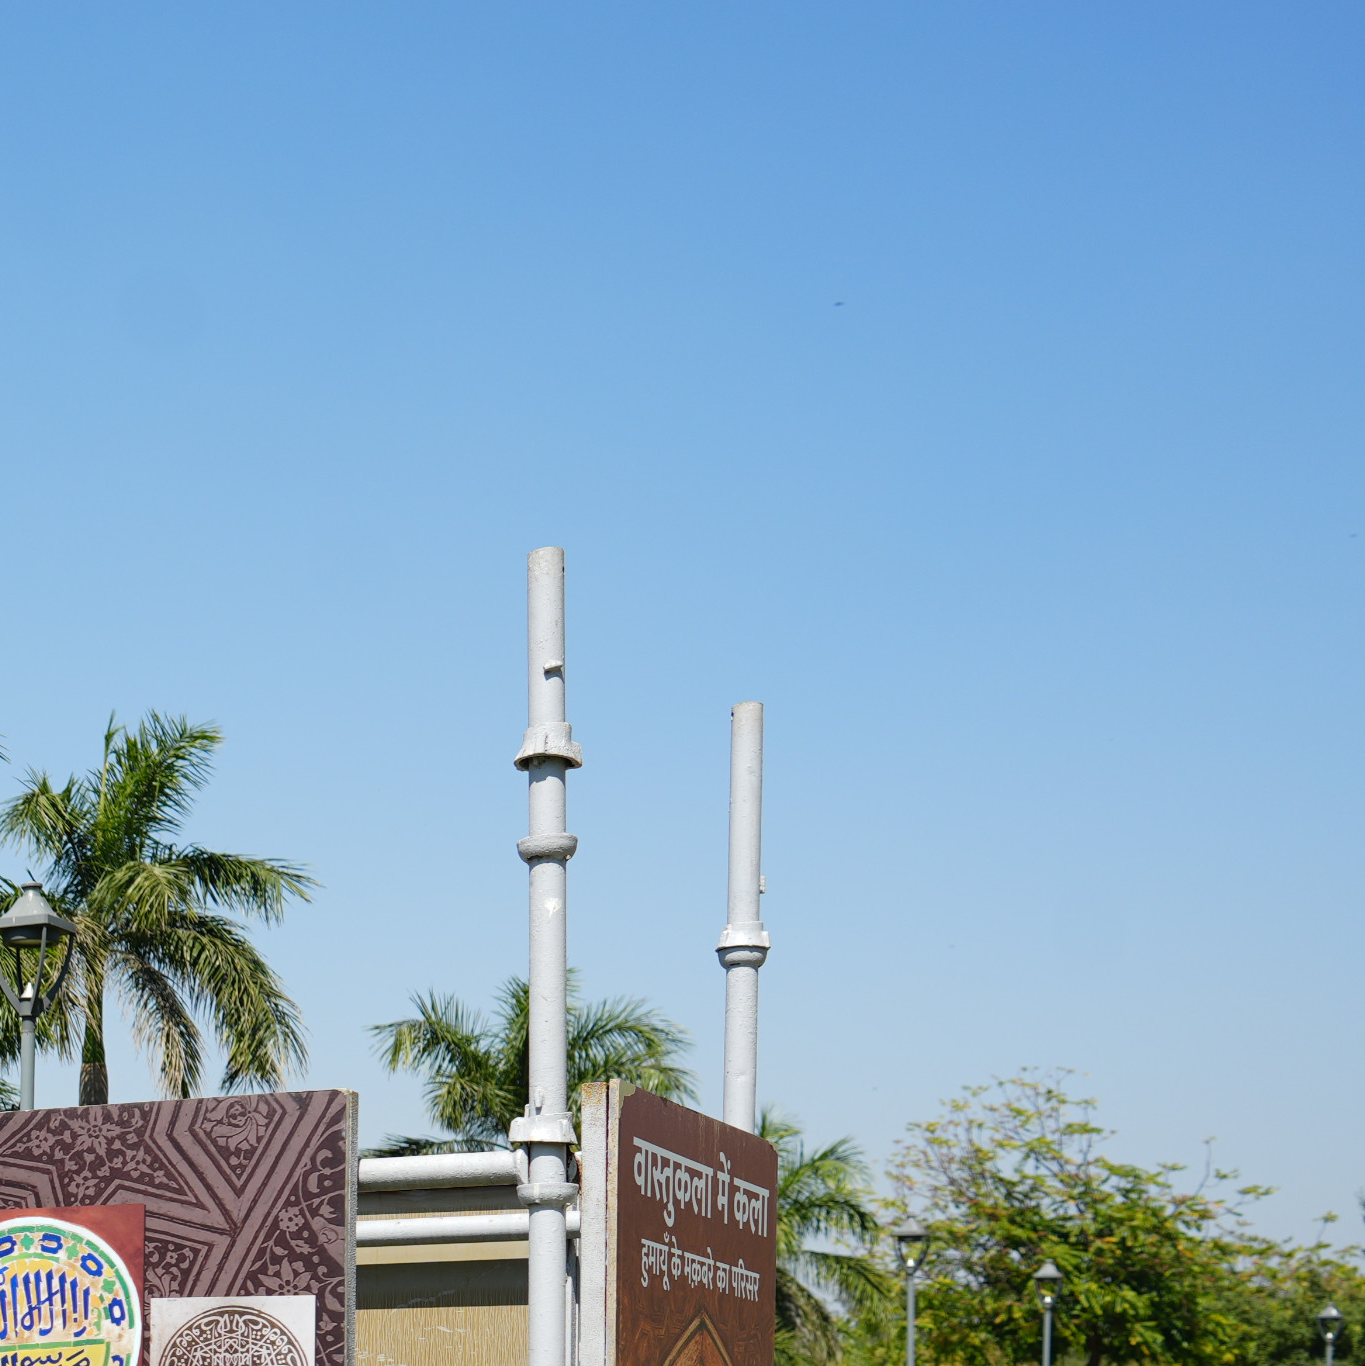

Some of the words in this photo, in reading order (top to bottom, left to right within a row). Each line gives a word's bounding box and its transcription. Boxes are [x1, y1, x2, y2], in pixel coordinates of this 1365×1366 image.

[633, 1136, 713, 1227] वास्तुकला
[717, 1152, 730, 1224] में
[734, 1177, 769, 1237] कला
[641, 1232, 670, 1291] हुमायूँ
[671, 1236, 682, 1280] के
[716, 1261, 730, 1294] का
[732, 1258, 760, 1302] परिसर
